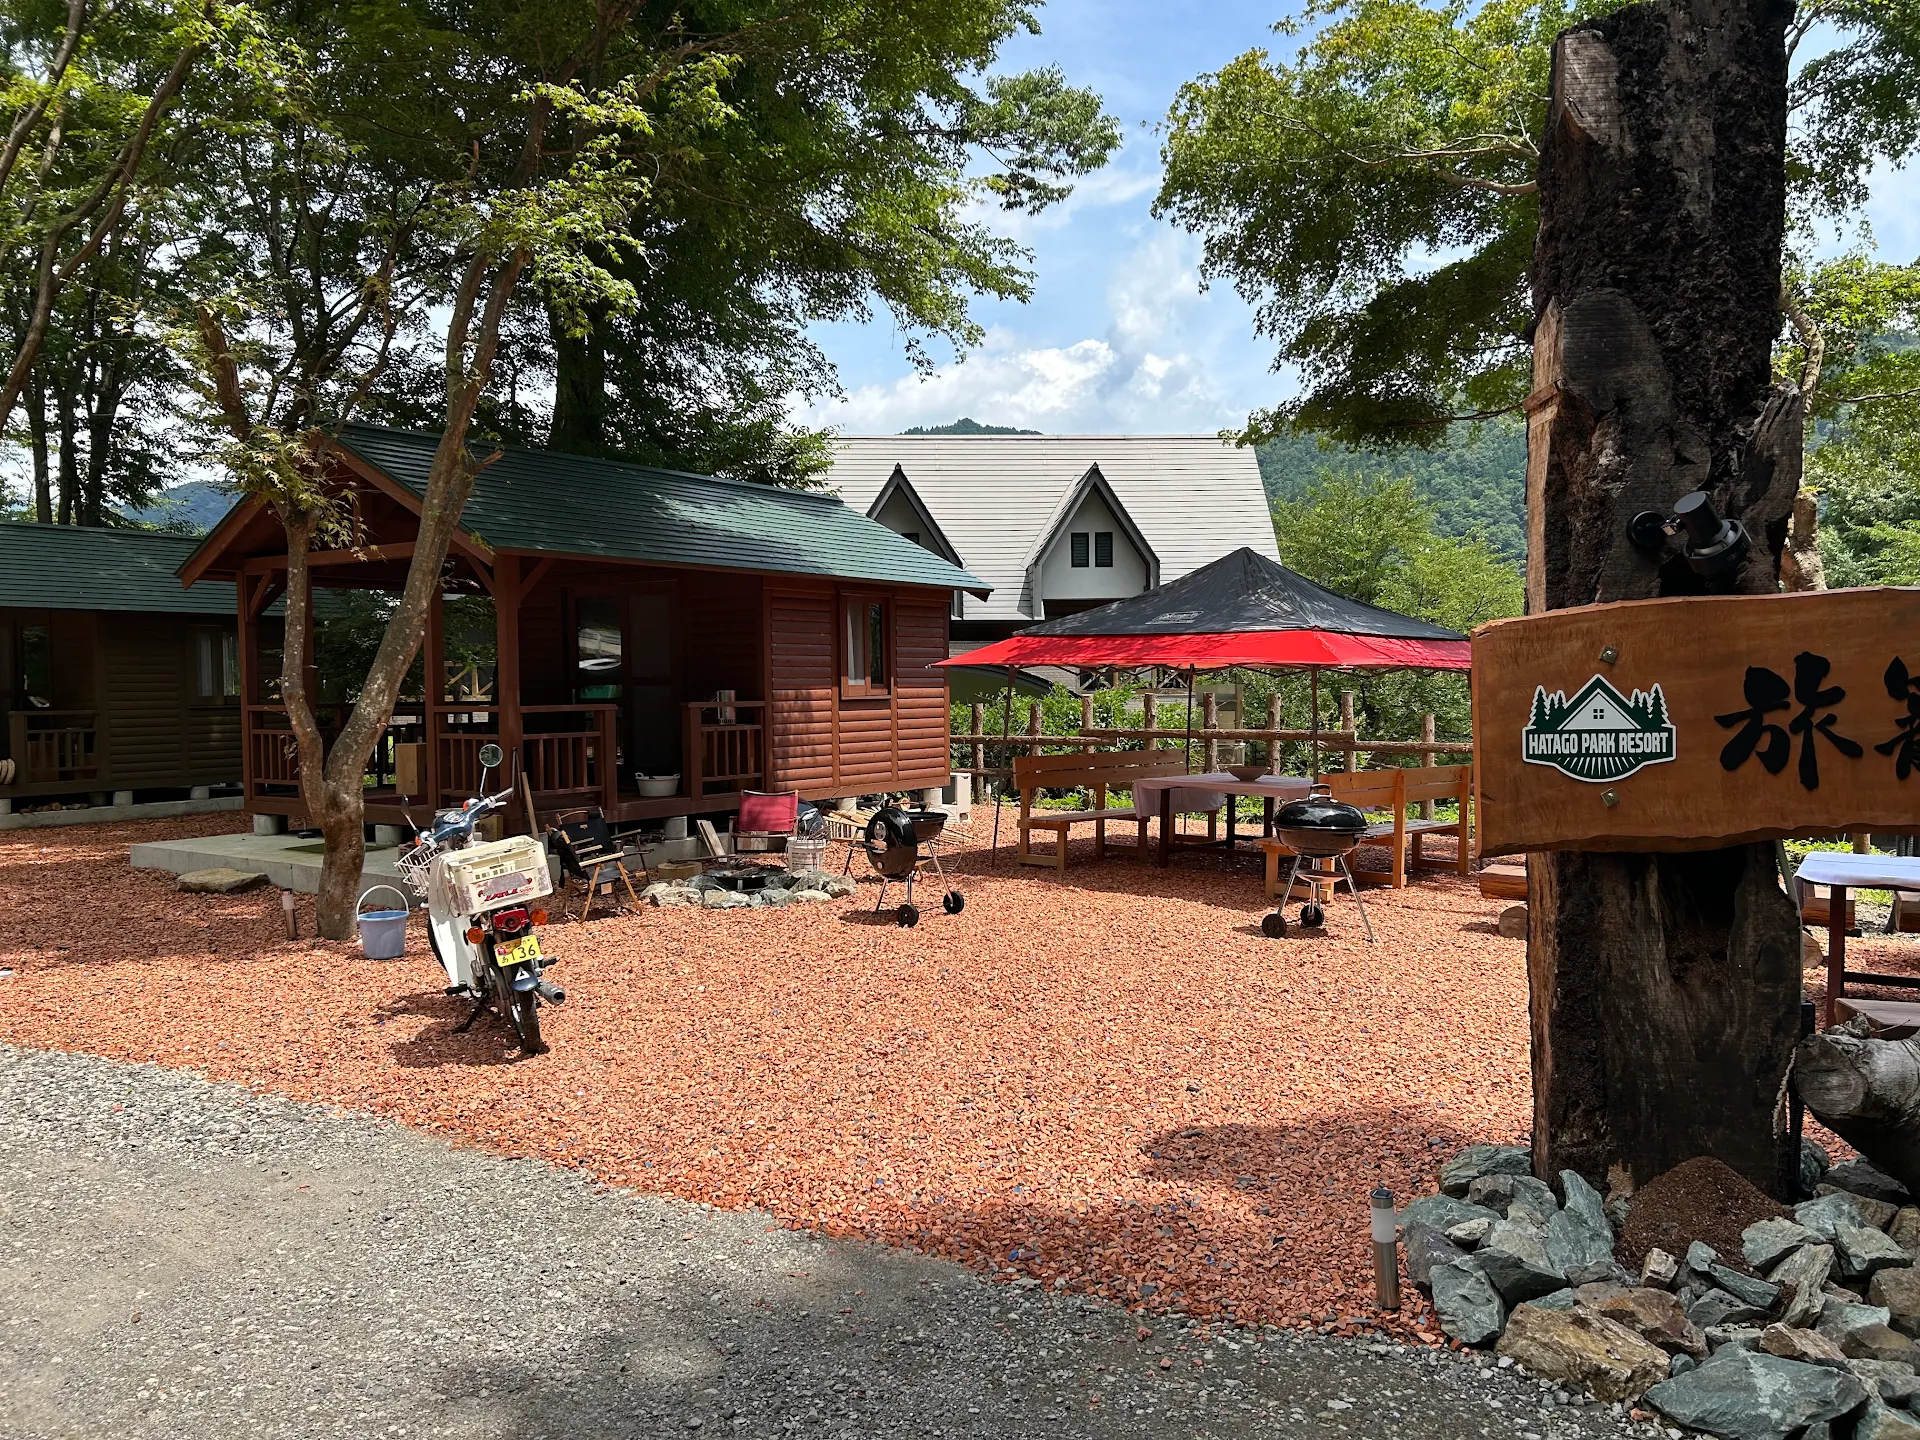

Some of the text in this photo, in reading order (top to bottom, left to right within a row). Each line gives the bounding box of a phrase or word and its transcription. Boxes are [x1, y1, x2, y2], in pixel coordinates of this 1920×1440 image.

[1528, 732, 1669, 755] HATAGO PARK RESORT
